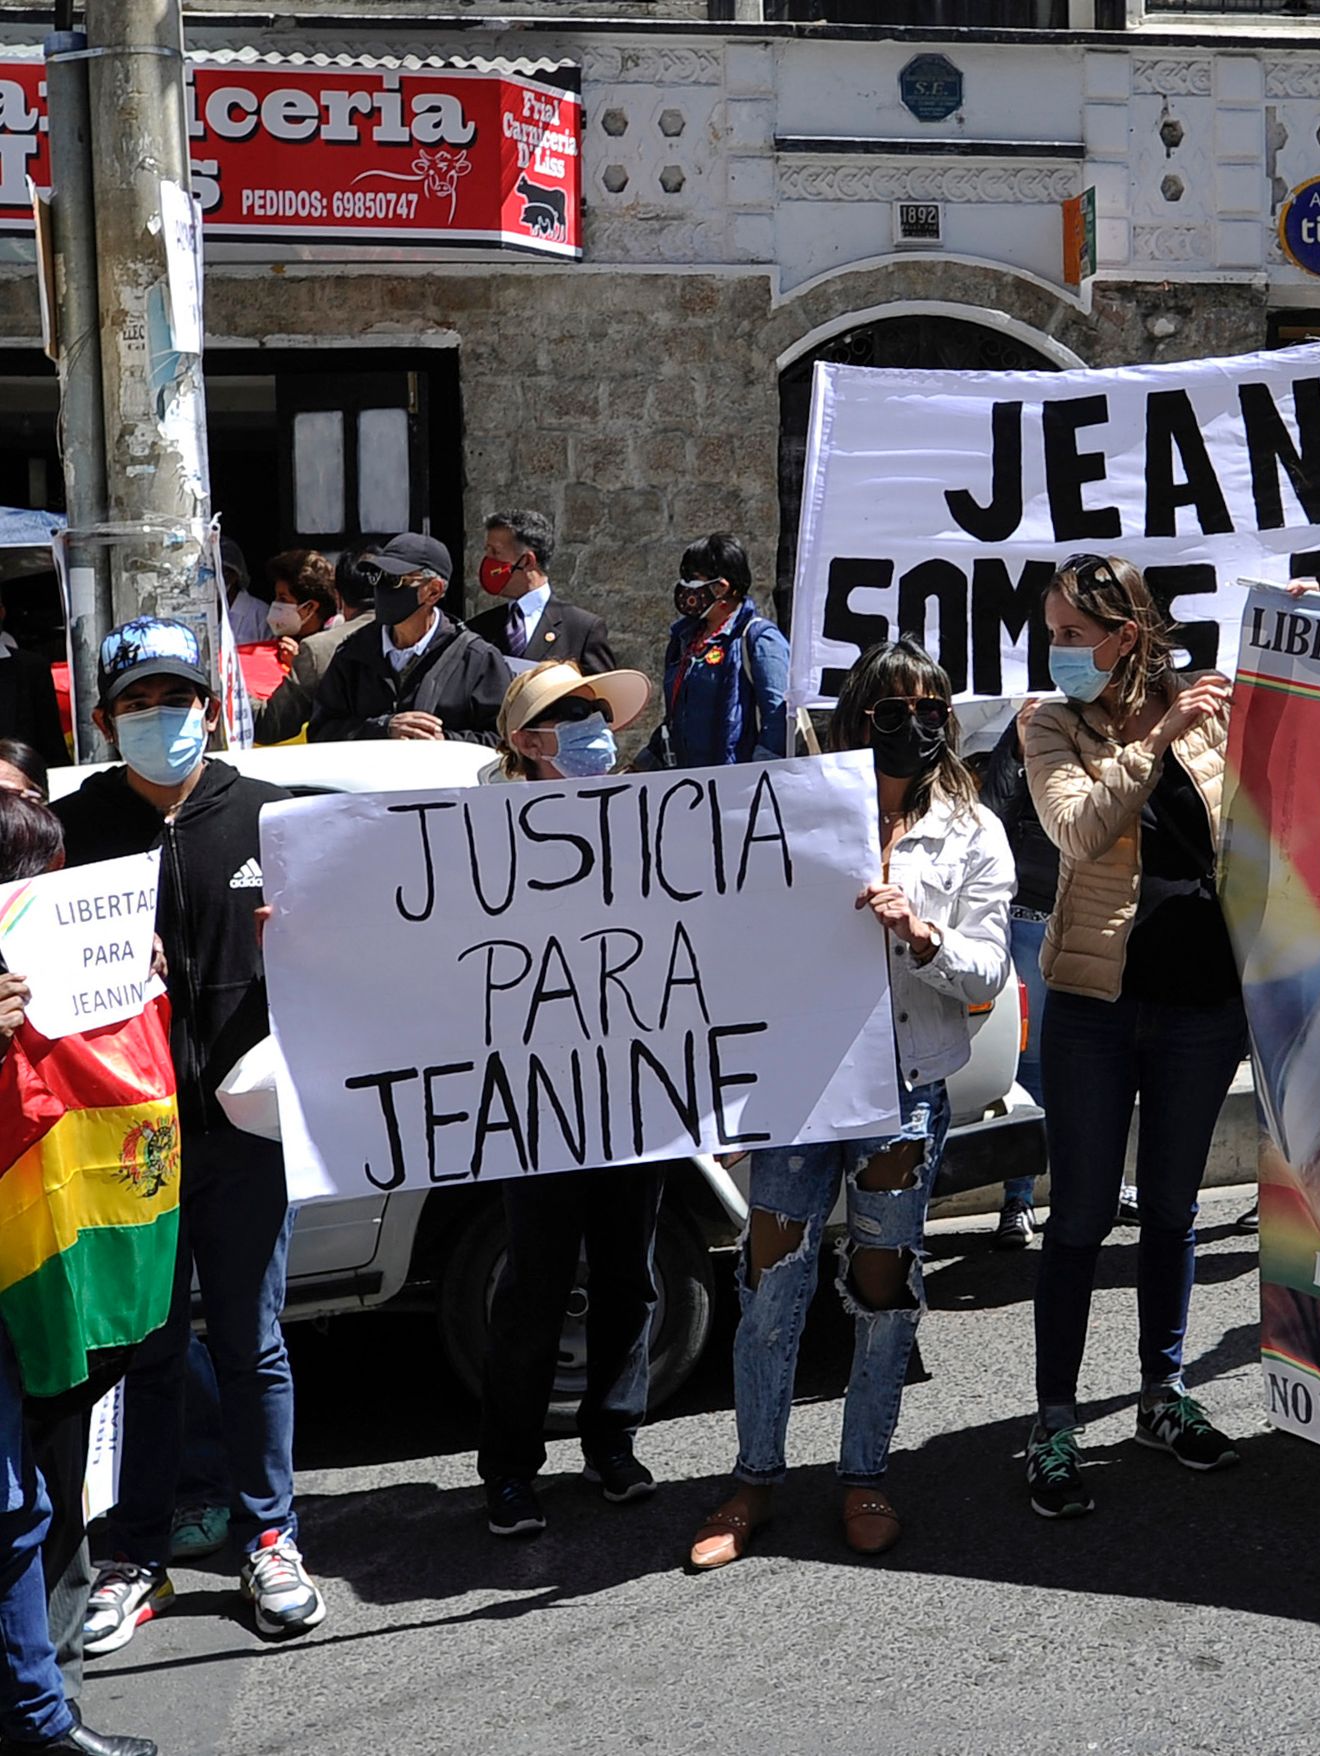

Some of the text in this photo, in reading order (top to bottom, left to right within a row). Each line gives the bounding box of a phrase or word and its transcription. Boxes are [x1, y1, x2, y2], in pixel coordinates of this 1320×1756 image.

[522, 90, 561, 127] Frial
[502, 111, 578, 157] Carniceria
[242, 189, 418, 219] PEDIDOS: 69850747
[902, 206, 937, 224] 1892
[820, 557, 1219, 697] SOMS
[387, 769, 793, 922] JUSTICIA
[82, 940, 135, 969] PARA
[458, 920, 711, 1047] PARA
[344, 1021, 772, 1192] JEANINE
[1267, 1372, 1313, 1425] NO
